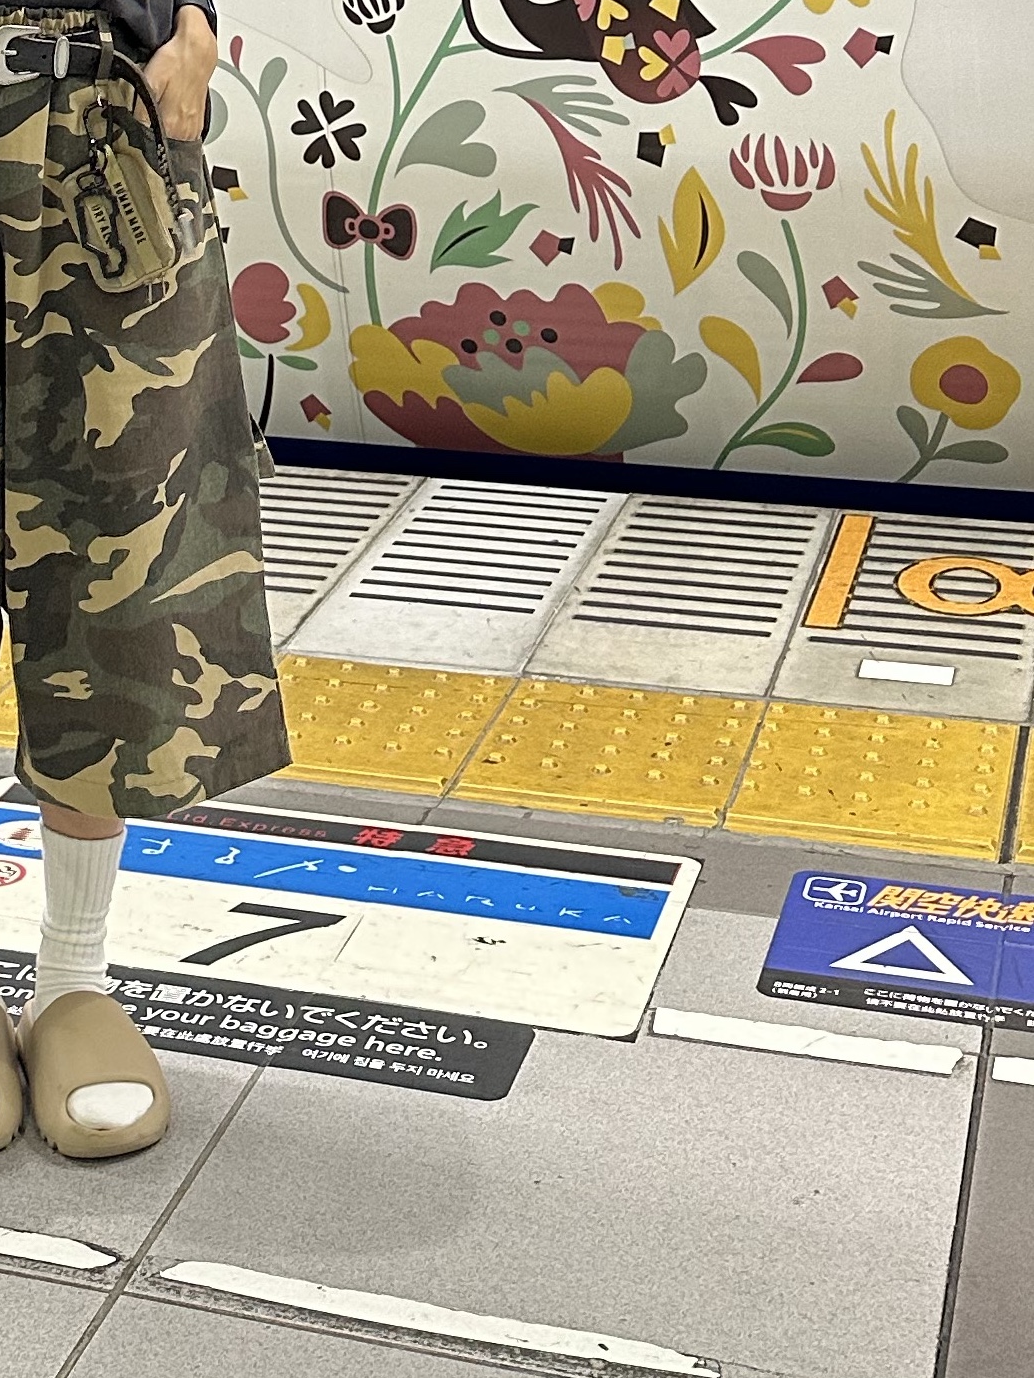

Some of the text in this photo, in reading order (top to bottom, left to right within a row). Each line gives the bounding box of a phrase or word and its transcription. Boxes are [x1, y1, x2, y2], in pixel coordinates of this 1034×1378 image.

[113, 182, 146, 245] HUMAN MADE
[352, 825, 477, 857] 特急
[179, 901, 347, 966] 7
[814, 901, 1030, 933] Kansai Airport Rapid Service
[140, 1007, 215, 1026] your
[219, 1014, 357, 1047] baggage
[364, 1035, 443, 1062] here.
[301, 1048, 350, 1064] 여기에
[389, 1062, 424, 1076] 두지
[426, 1068, 475, 1084] 마세요
